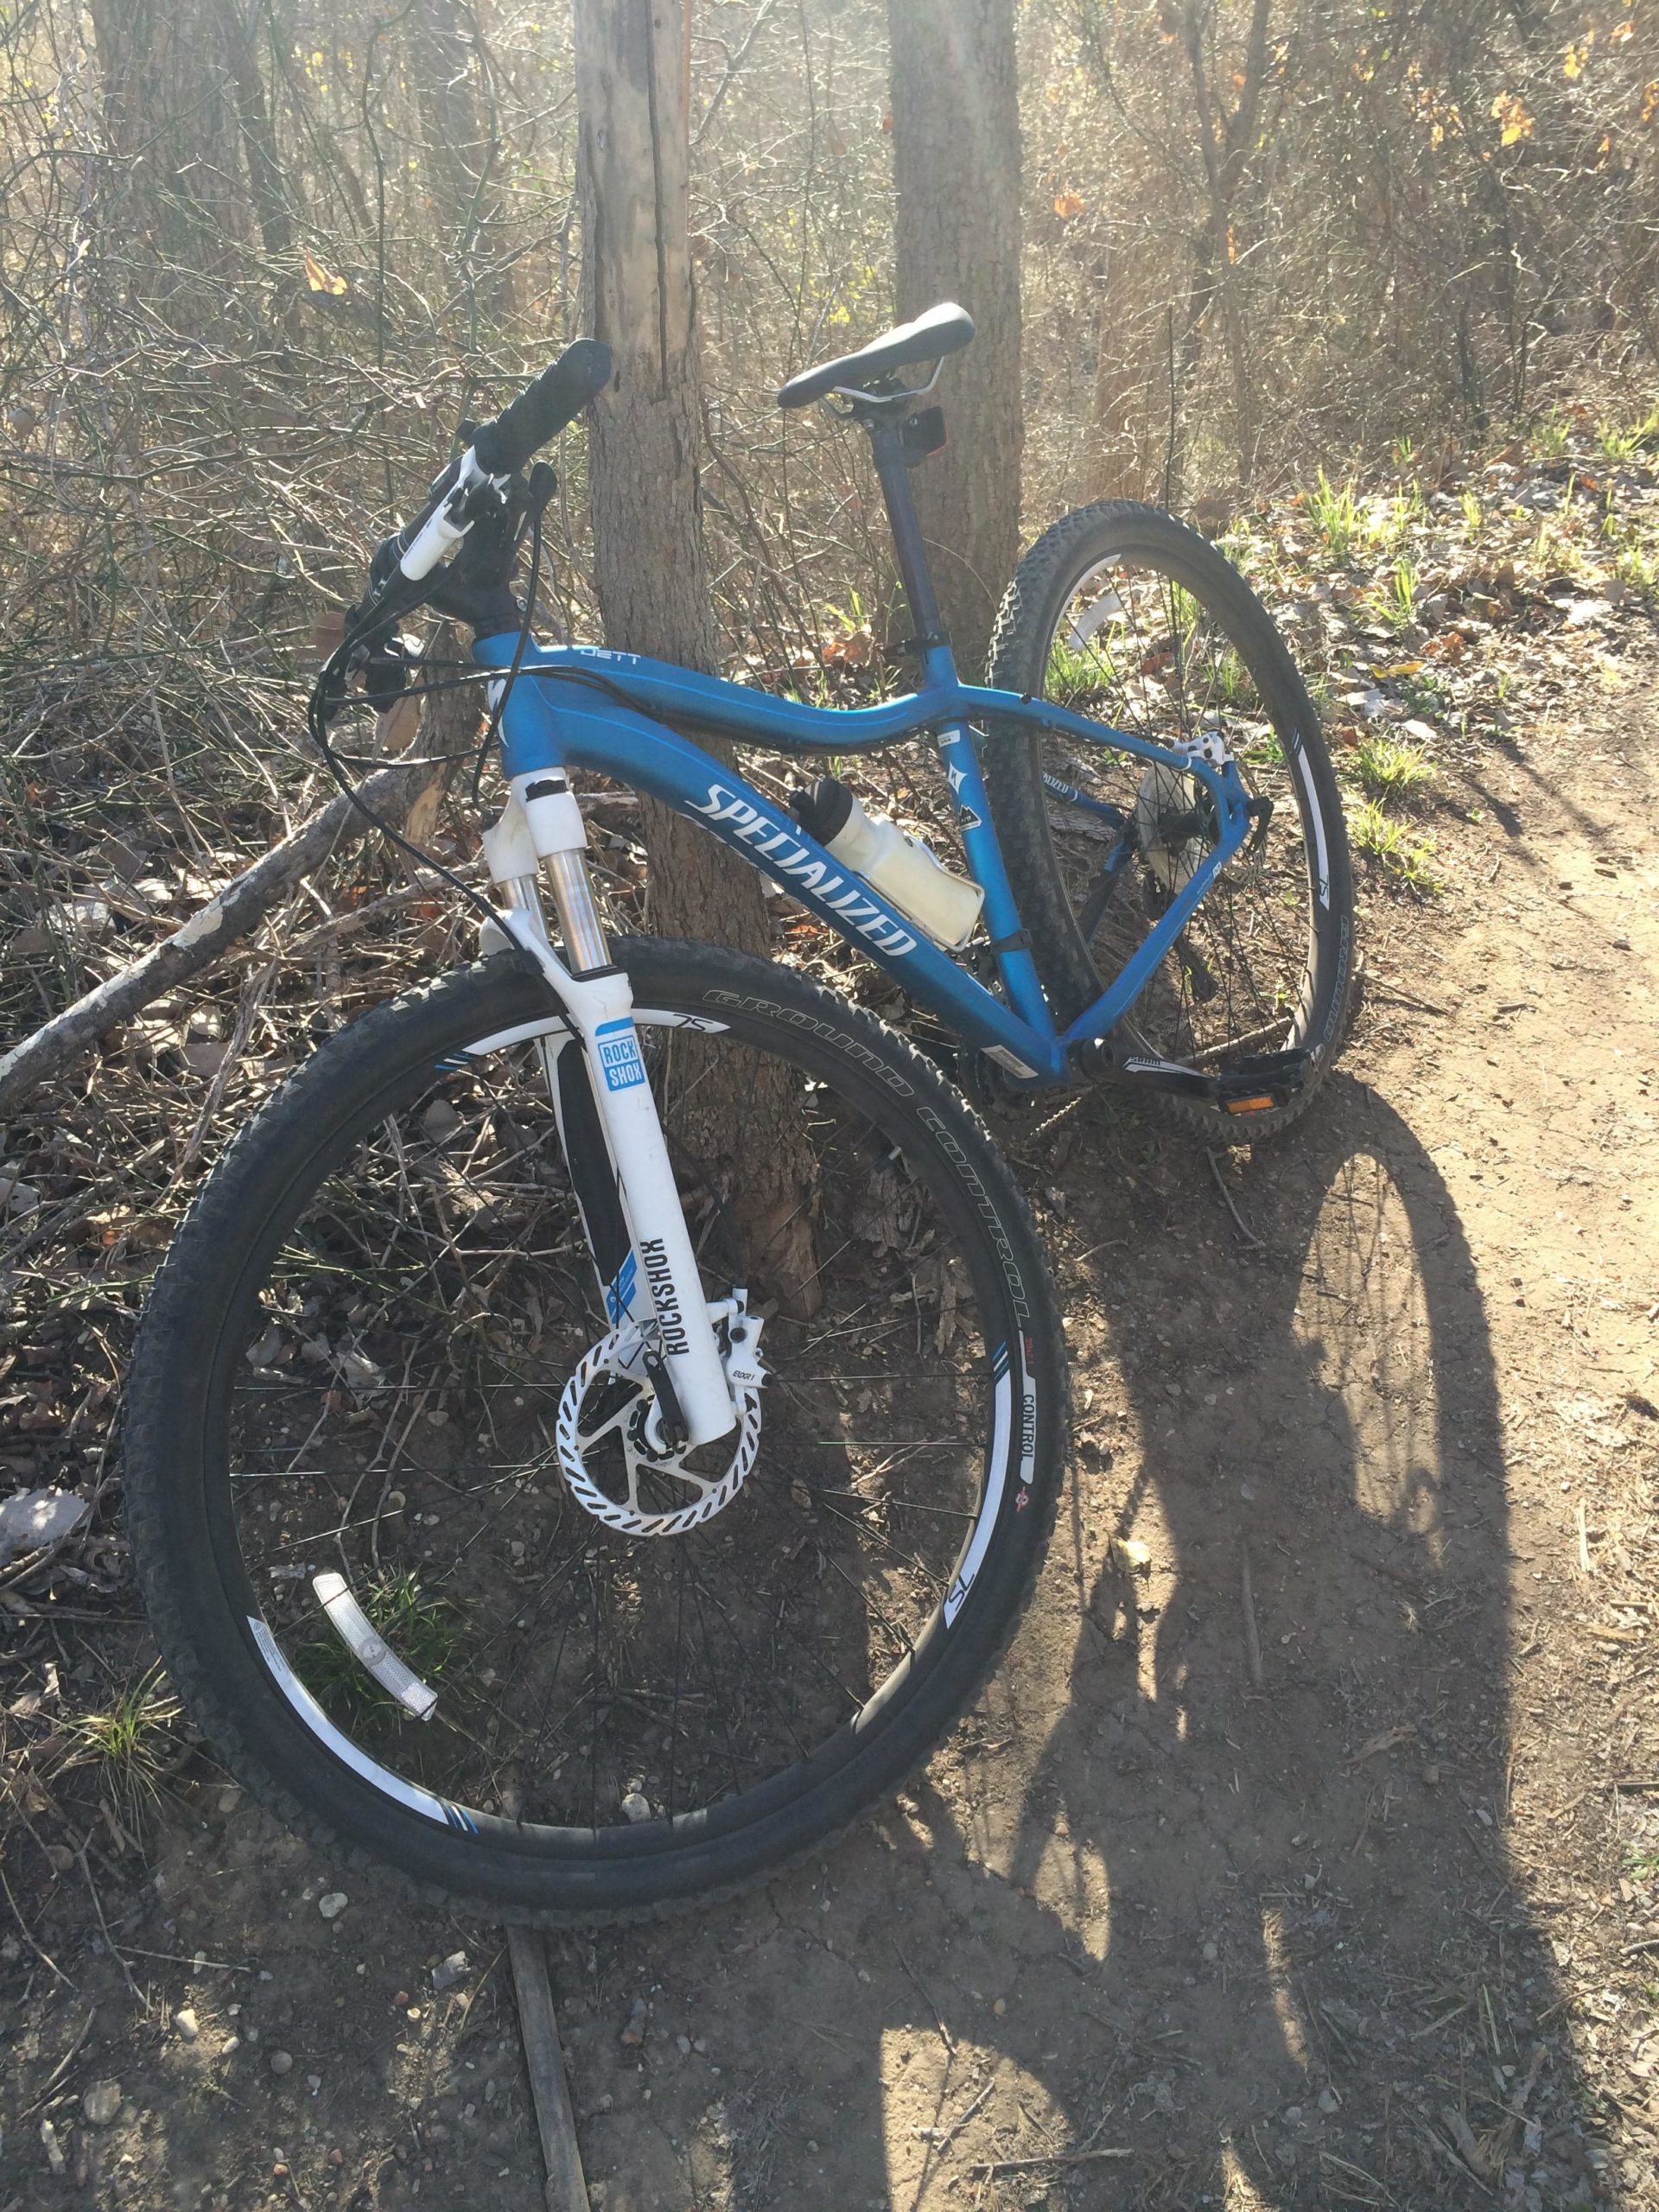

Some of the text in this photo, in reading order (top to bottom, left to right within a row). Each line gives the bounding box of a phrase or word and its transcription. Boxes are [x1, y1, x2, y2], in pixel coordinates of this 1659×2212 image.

[684, 784, 918, 957] SPECIALIZED
[602, 1041, 638, 1065] ROCK
[608, 1062, 643, 1087] SHOX
[702, 989, 1030, 1327] GROUND CONTROL
[640, 1238, 690, 1356] ROCKSHOX
[1021, 1394, 1034, 1461] CONTROL
